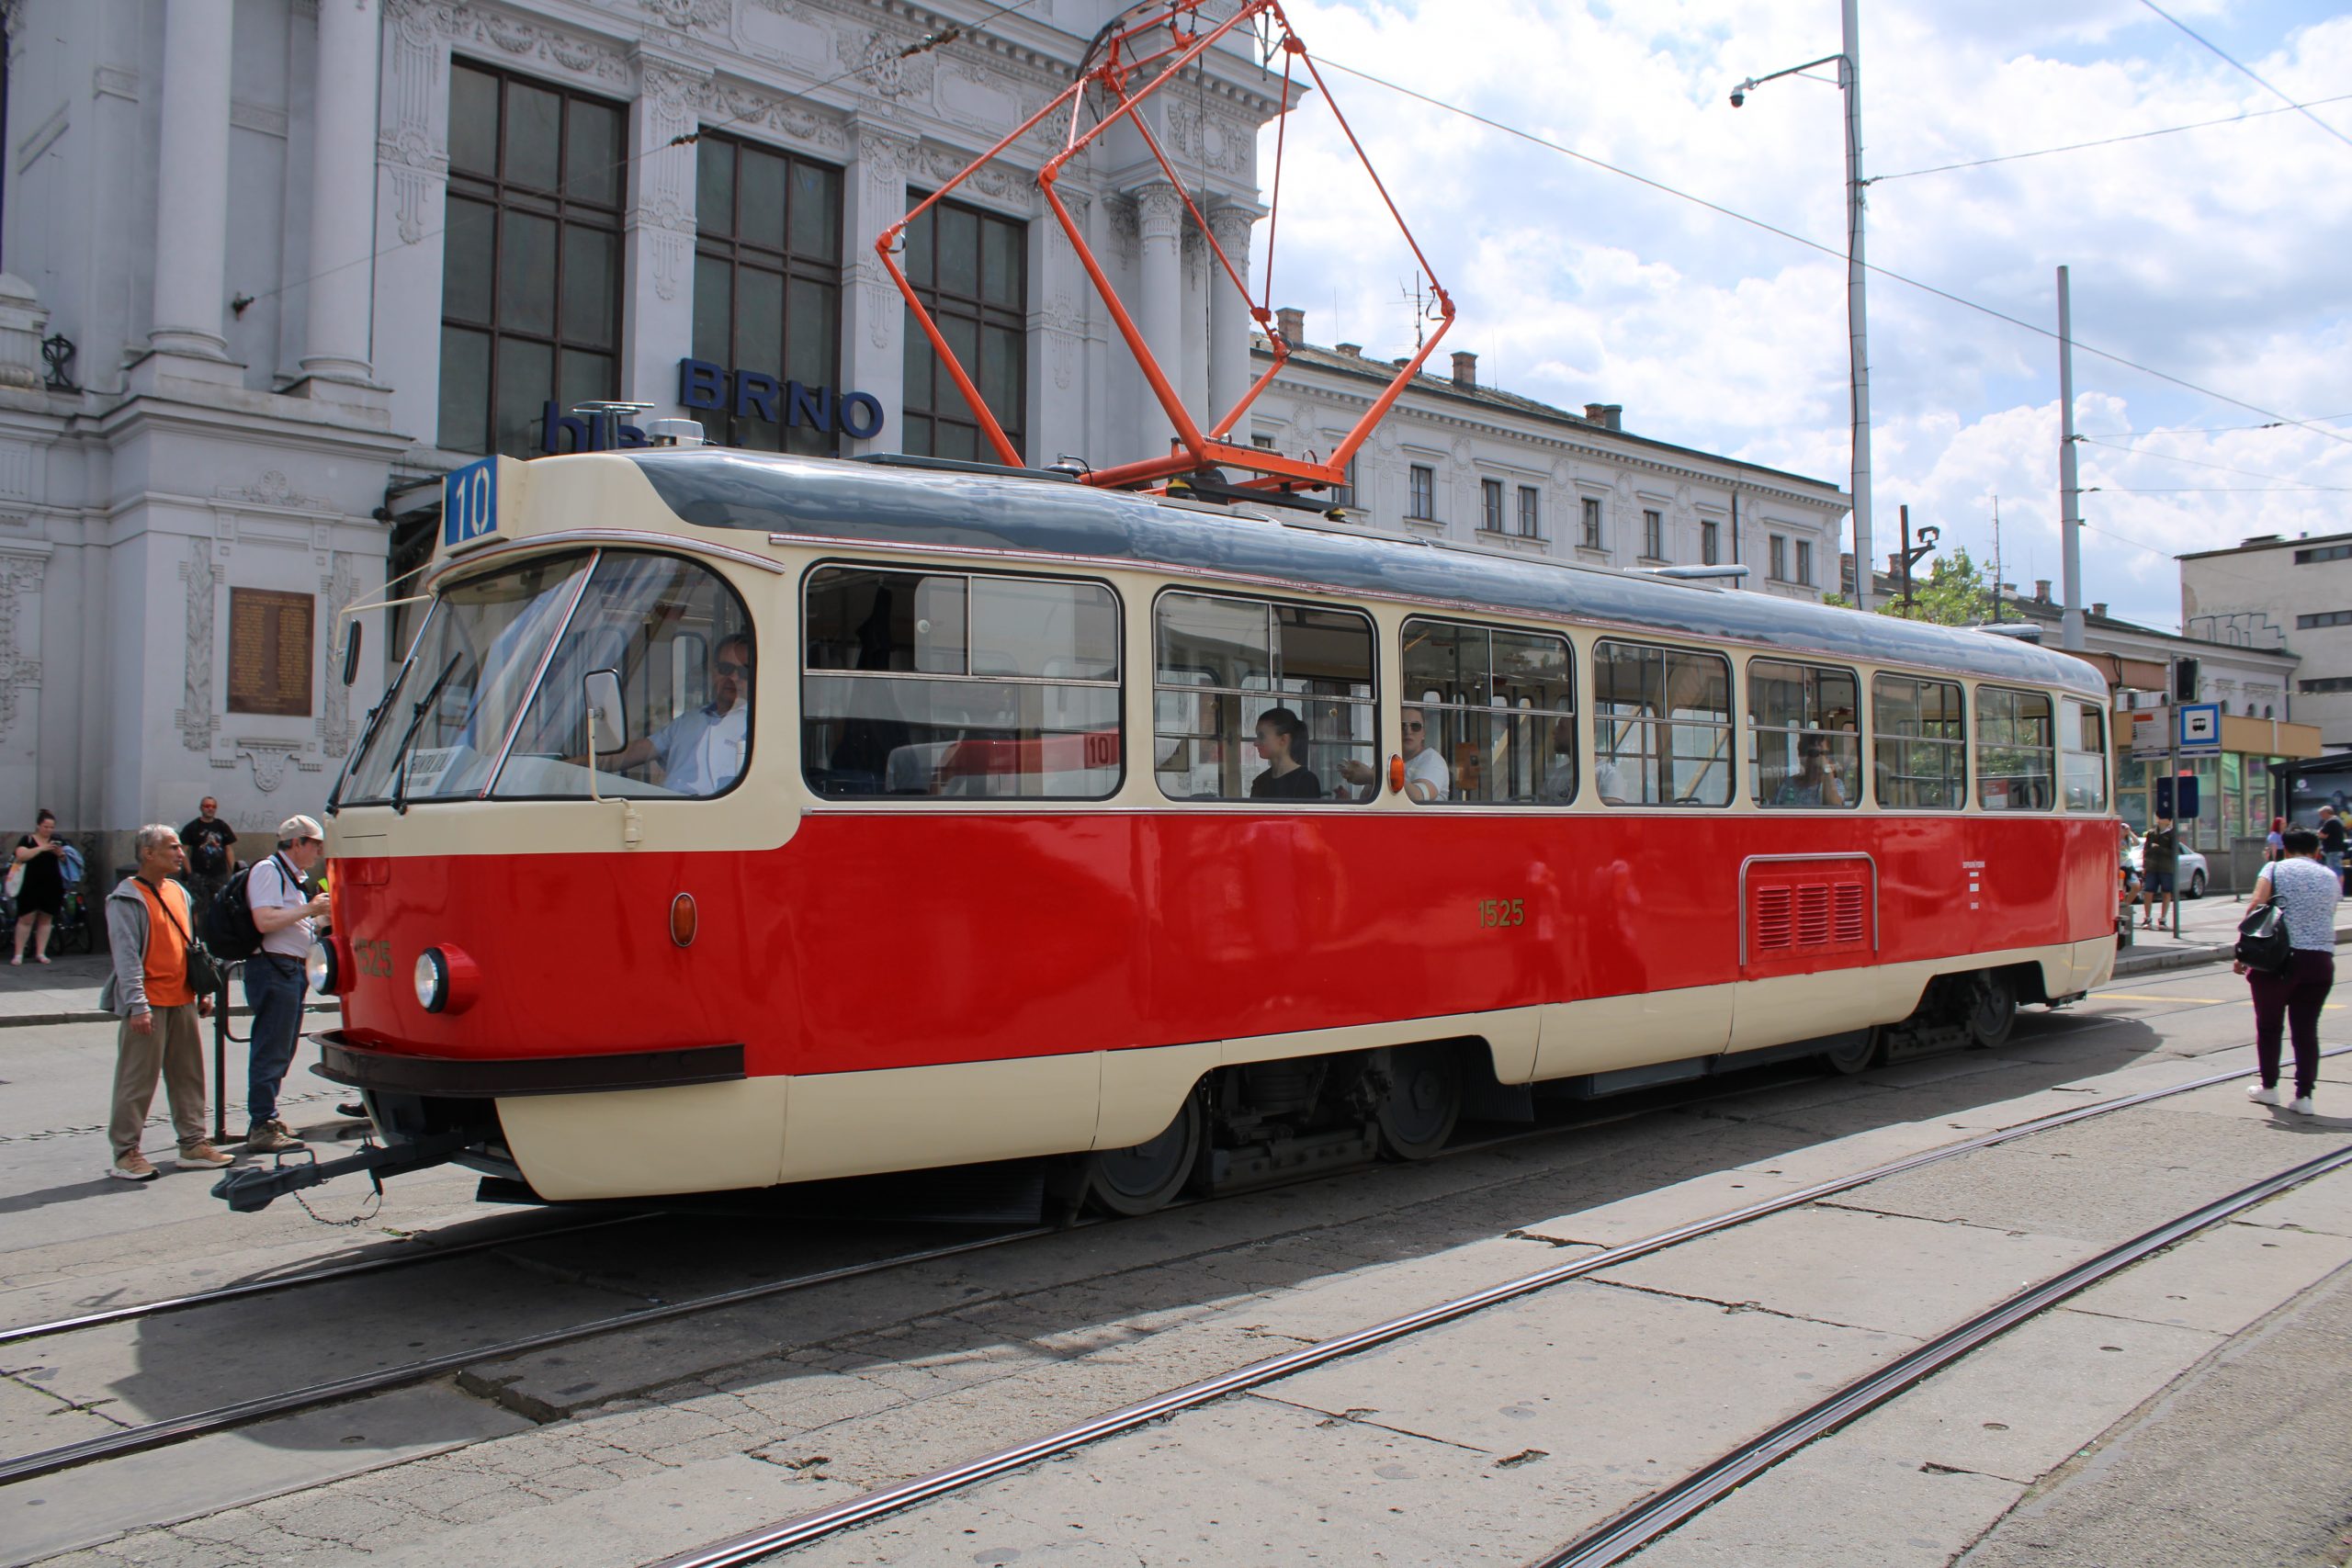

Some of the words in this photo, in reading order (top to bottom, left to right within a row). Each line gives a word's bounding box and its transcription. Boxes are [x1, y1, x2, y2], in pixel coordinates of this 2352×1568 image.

[680, 358, 885, 439] BRNO
[456, 467, 490, 542] 10
[1090, 736, 1109, 764] 10
[1478, 898, 1525, 929] 1525
